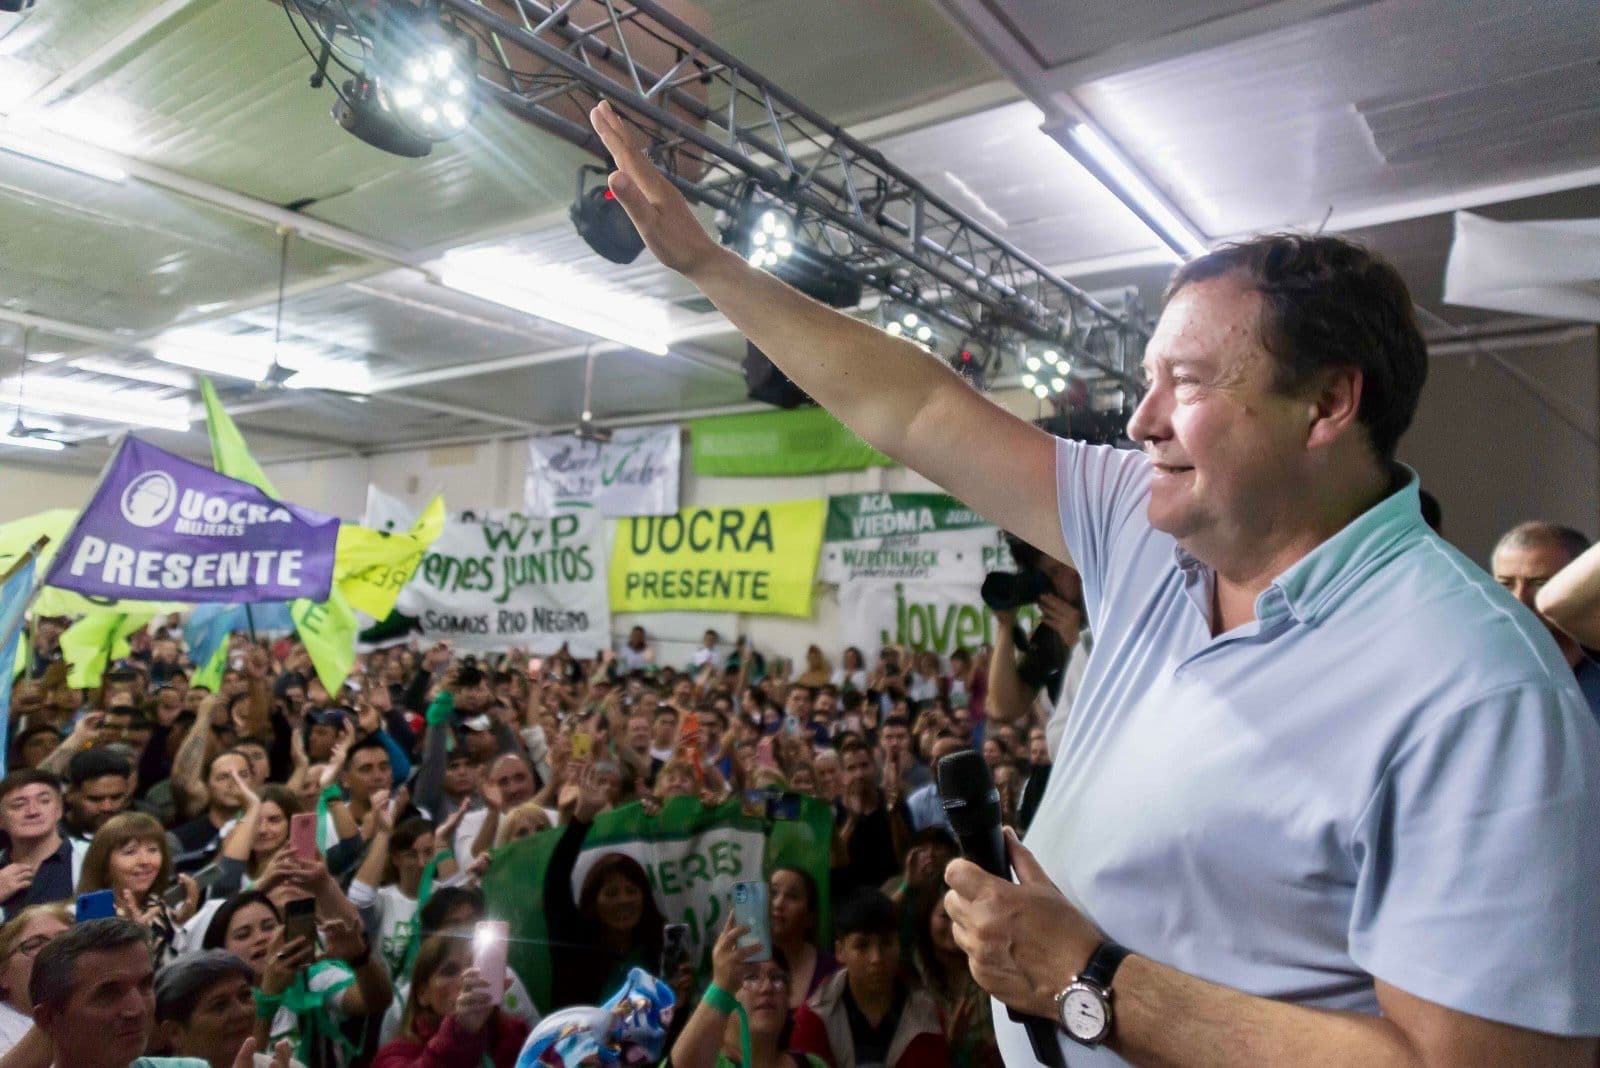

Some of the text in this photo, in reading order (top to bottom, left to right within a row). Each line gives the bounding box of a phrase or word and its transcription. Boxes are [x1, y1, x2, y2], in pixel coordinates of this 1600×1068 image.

[859, 495, 893, 512] ACA
[174, 518, 245, 536] MUJERES
[551, 514, 578, 548] P
[630, 509, 774, 555] UOCRA
[852, 508, 936, 538] VIEDMA
[70, 535, 304, 589] PRESENTE
[423, 552, 494, 592] enes
[626, 570, 769, 601] PRESENTE
